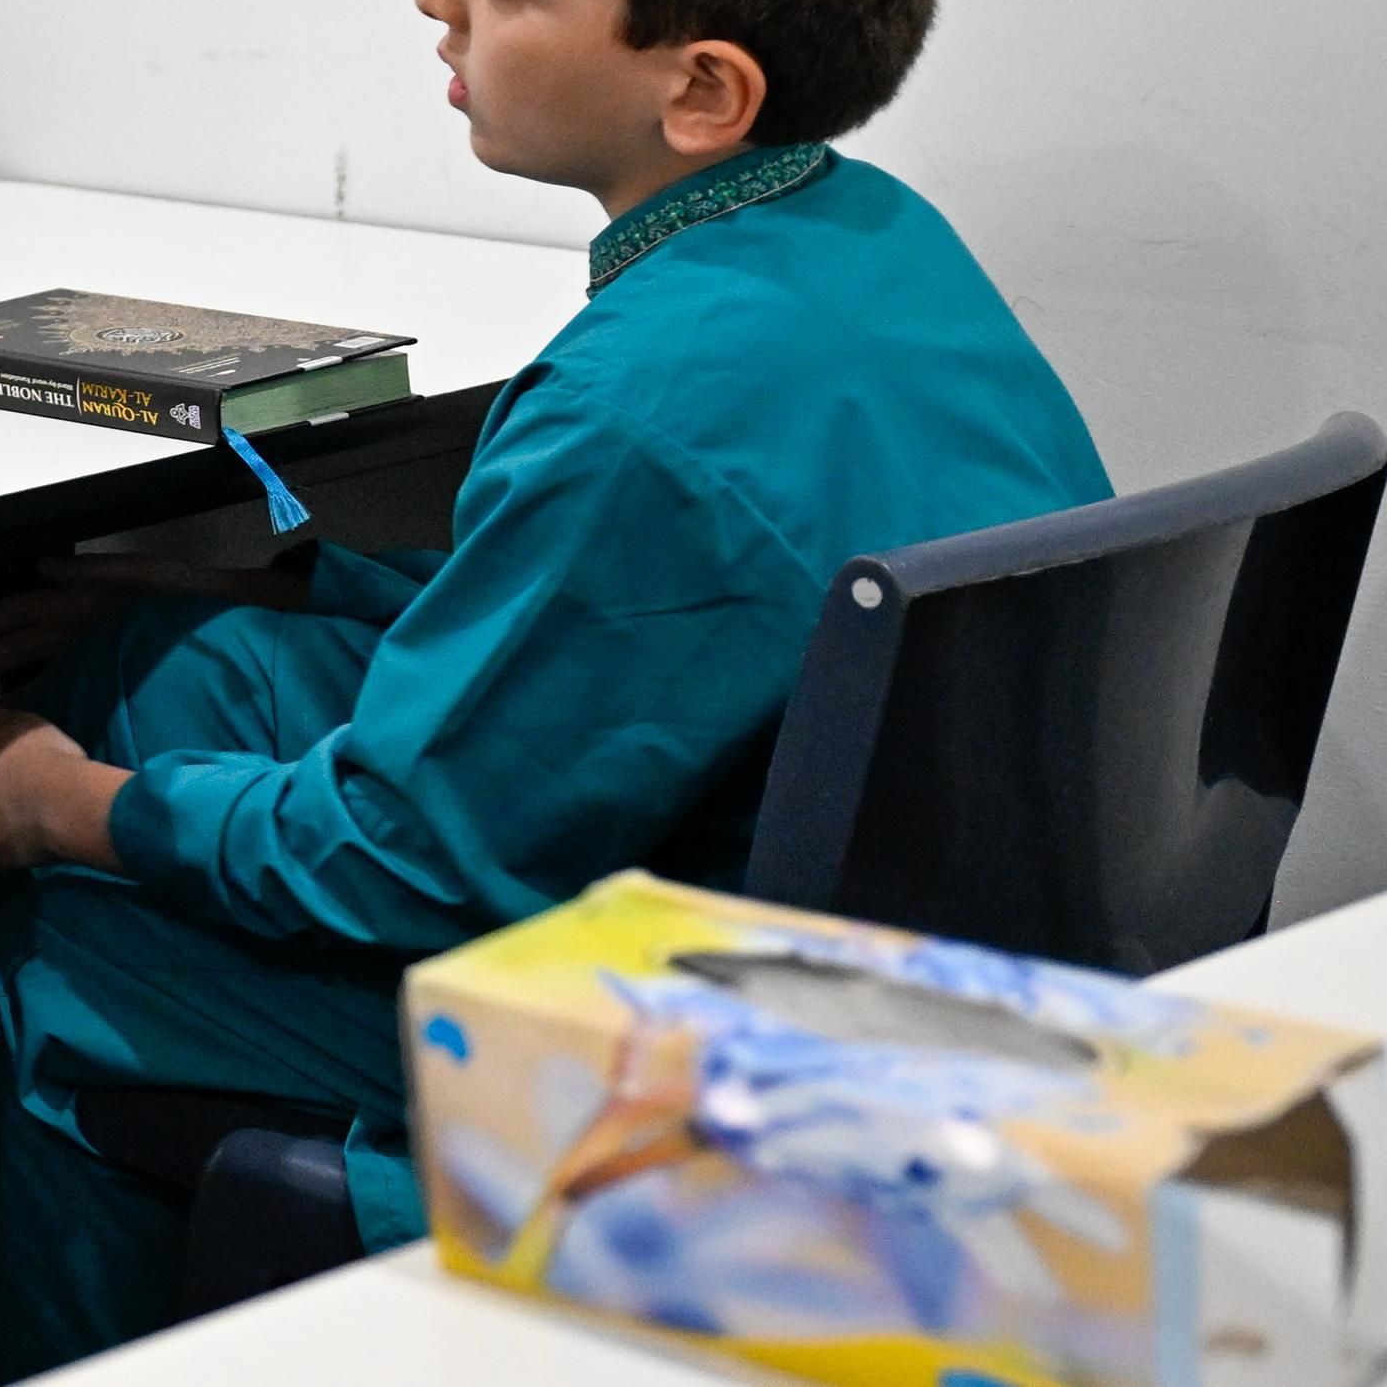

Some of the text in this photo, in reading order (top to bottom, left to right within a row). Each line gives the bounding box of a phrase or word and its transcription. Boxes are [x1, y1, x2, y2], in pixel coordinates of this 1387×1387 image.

[44, 390, 75, 408] THE
[81, 381, 153, 407] AL-KARIM
[82, 399, 160, 426] AL-QURAN
